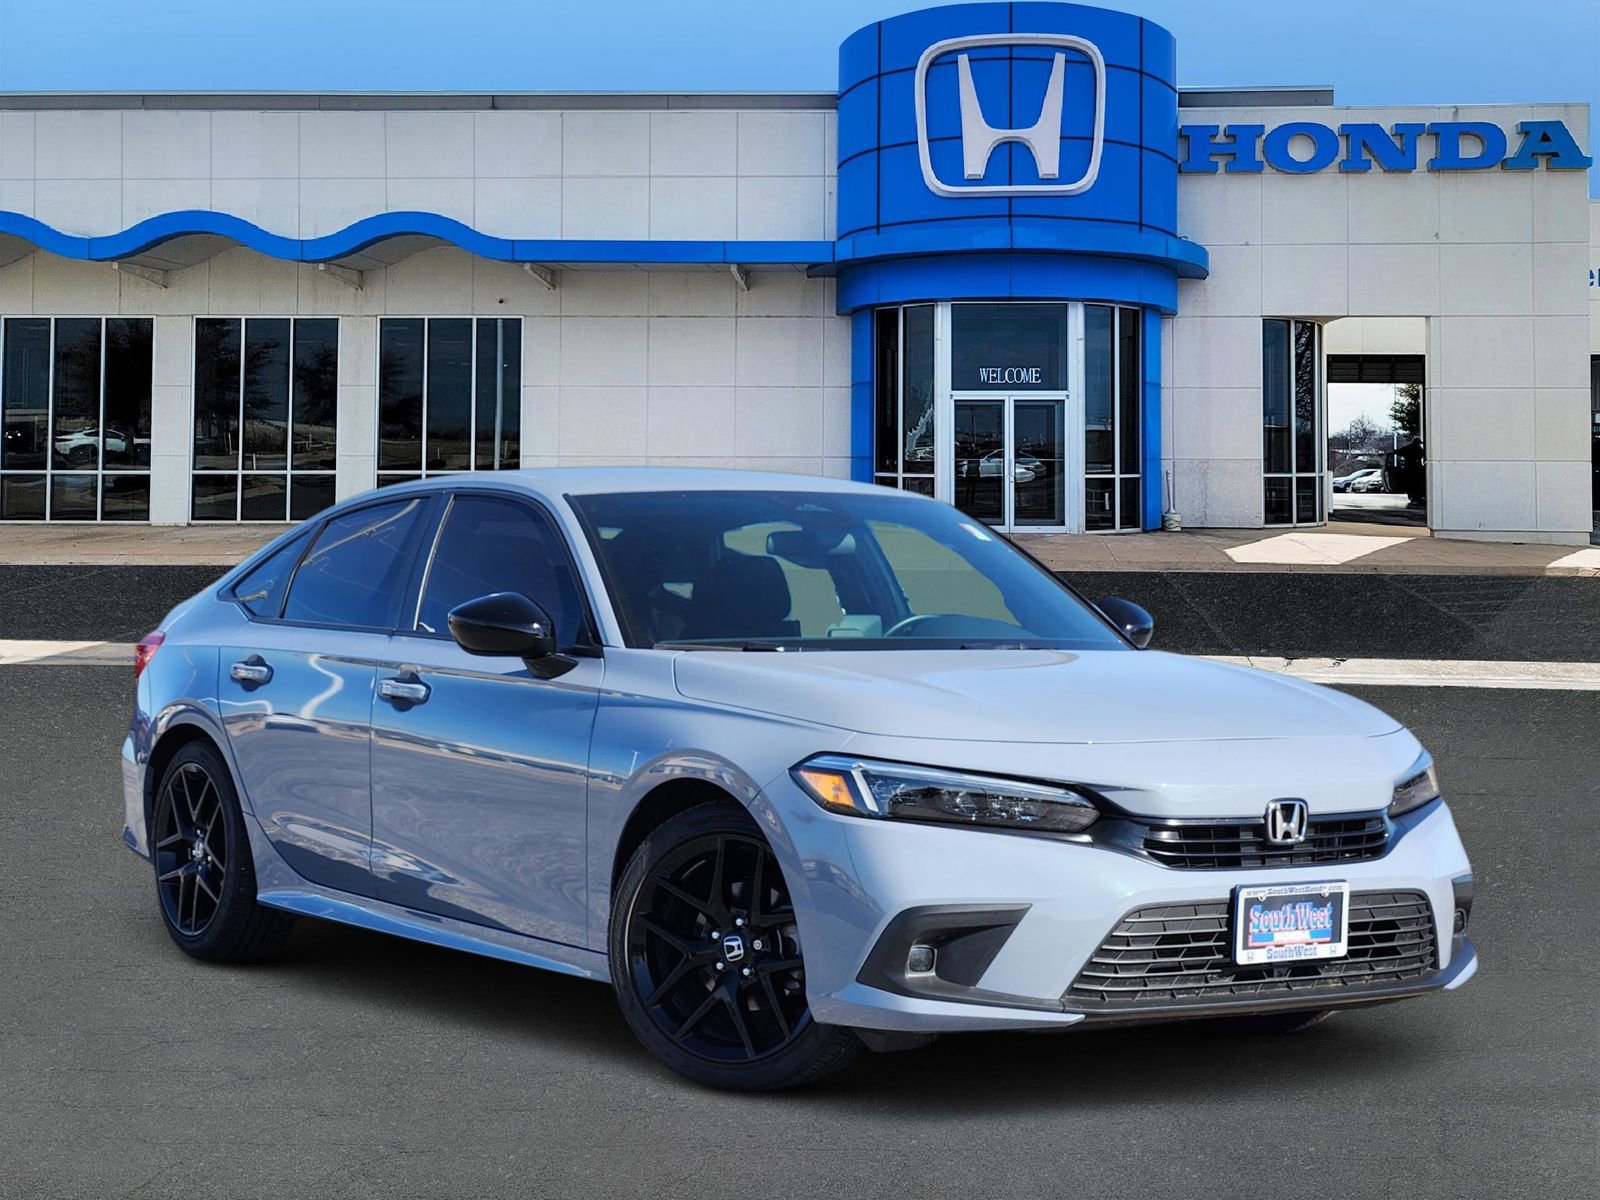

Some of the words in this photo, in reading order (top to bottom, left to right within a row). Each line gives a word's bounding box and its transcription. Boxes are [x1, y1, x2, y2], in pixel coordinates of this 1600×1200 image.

[1178, 120, 1593, 174] HONDA
[979, 368, 1042, 384] WELCOME
[1249, 901, 1333, 933] SouthWest
[1266, 945, 1318, 960] SouthWest
